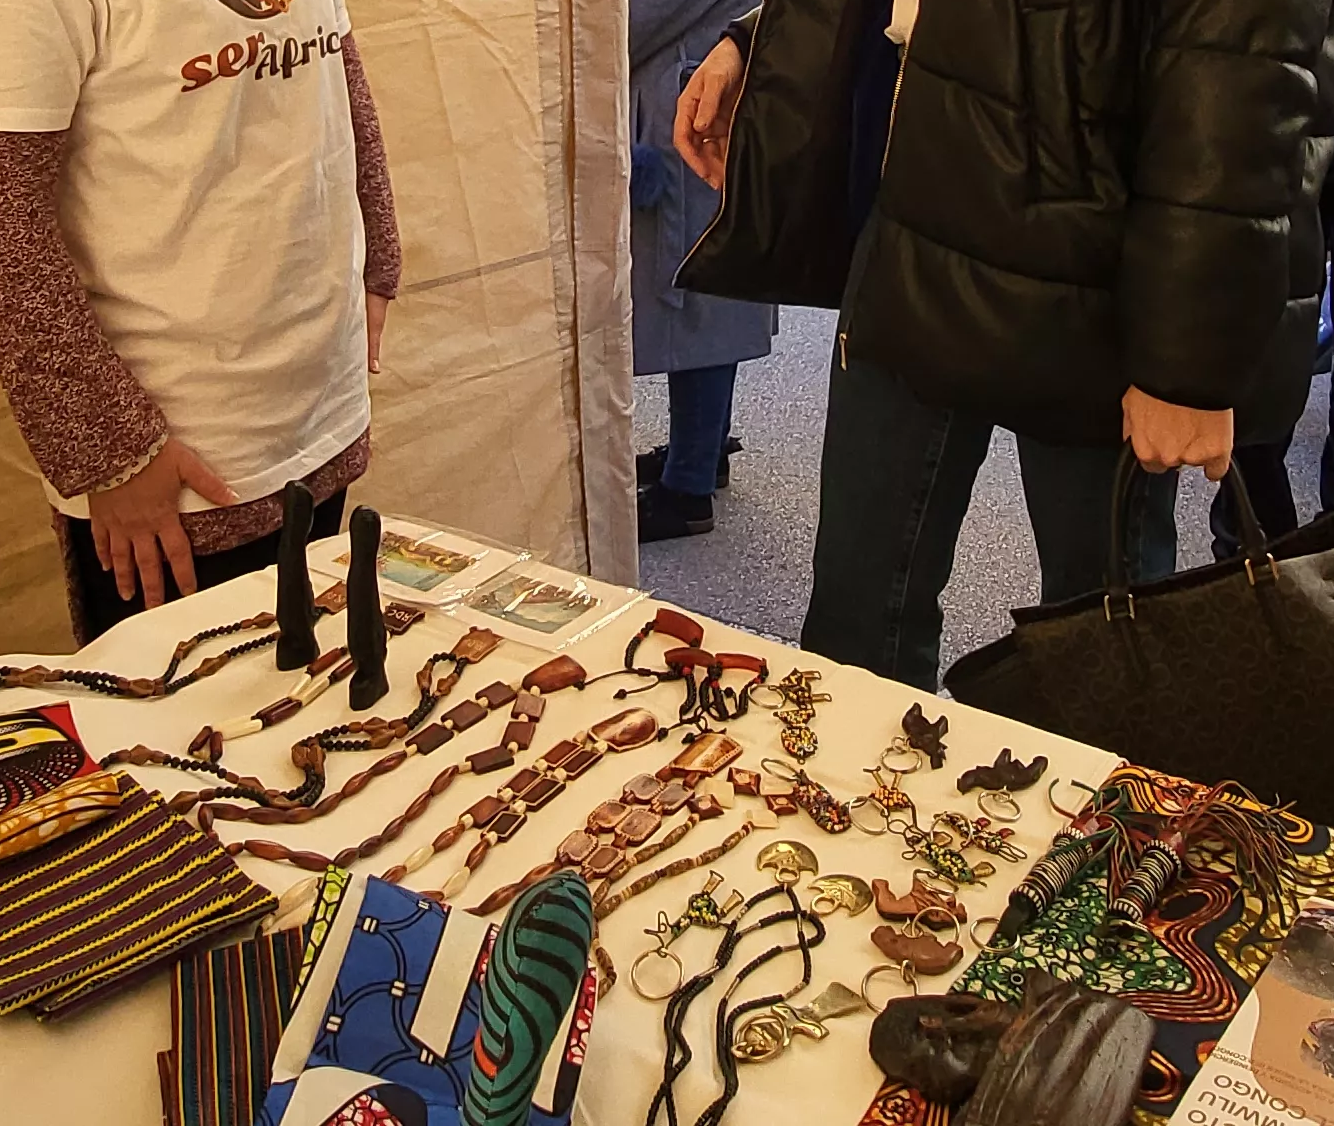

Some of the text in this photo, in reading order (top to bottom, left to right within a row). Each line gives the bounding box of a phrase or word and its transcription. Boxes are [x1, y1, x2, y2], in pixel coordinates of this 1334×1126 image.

[180, 25, 342, 92] ser Afric
[387, 609, 413, 622] RDC
[1214, 1075, 1307, 1120] CONGO
